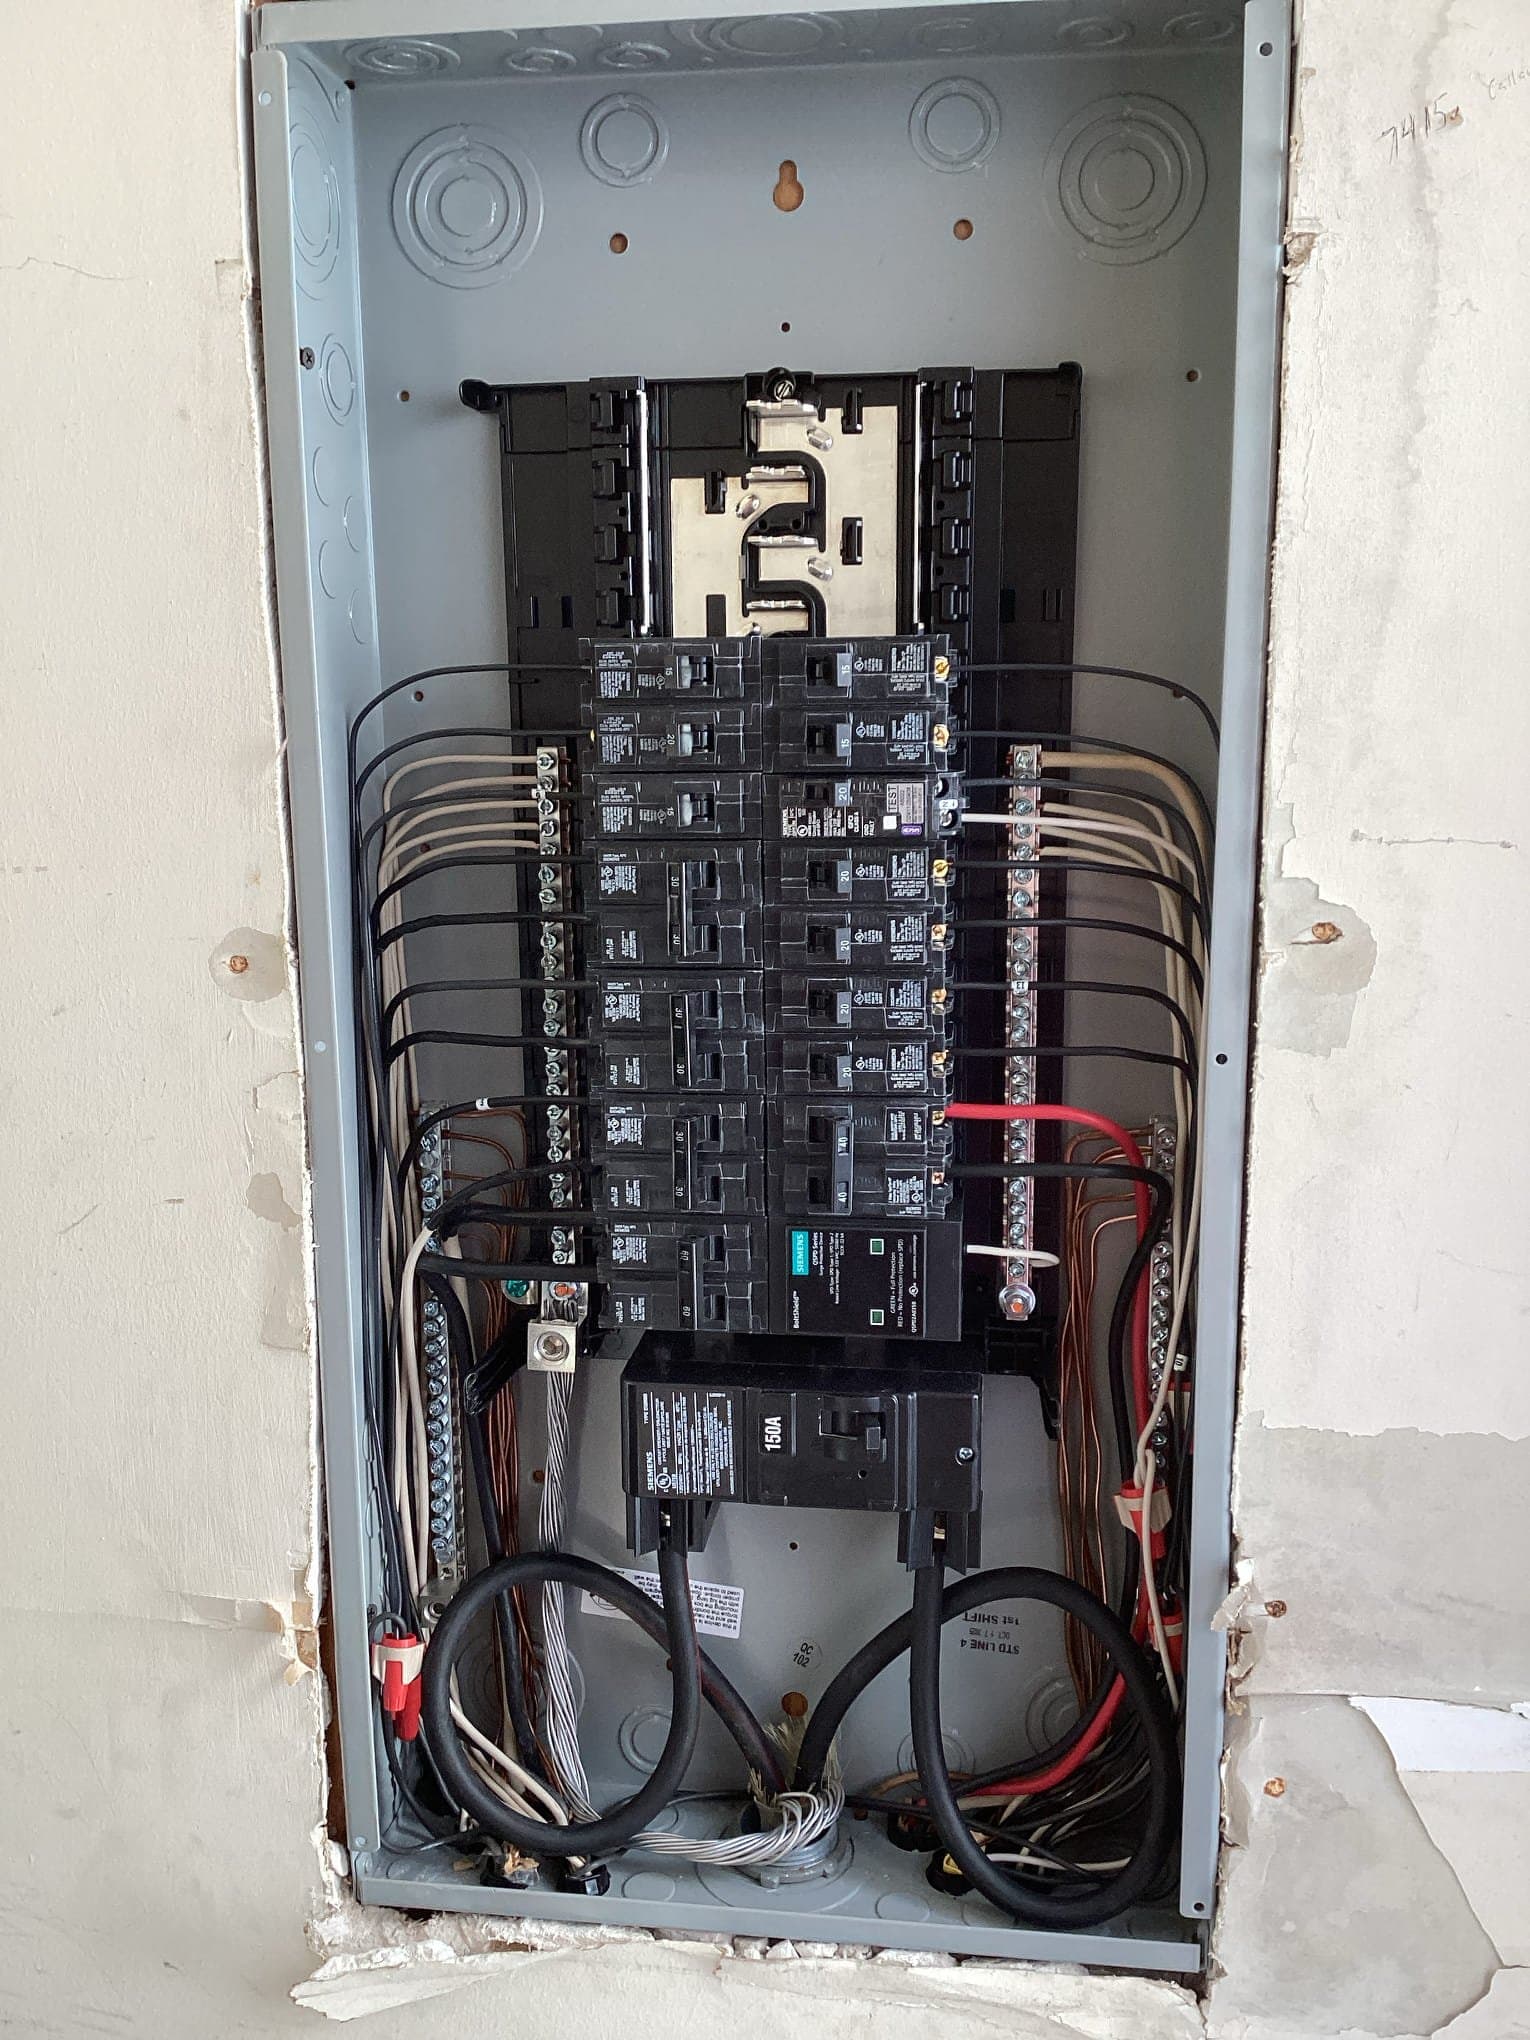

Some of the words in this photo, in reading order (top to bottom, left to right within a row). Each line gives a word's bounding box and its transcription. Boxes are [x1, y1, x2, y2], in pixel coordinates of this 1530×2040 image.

[666, 667, 674, 676] 15
[840, 664, 850, 675] 15
[667, 734, 675, 745] 20
[841, 738, 850, 749] 15
[838, 787, 848, 801] 20
[888, 786, 897, 812] TEST
[667, 806, 675, 816] 15
[671, 876, 680, 887] 30
[840, 870, 850, 882] 20
[840, 940, 850, 951] 20
[840, 1003, 850, 1014] 20
[676, 1063, 685, 1074] 30
[842, 1067, 852, 1078] 20
[675, 1131, 684, 1141] 30
[838, 1137, 848, 1148] 40
[675, 1186, 684, 1197] 30
[838, 1192, 847, 1203] 40
[796, 1233, 805, 1273] SIEMENS
[764, 1416, 782, 1451] 150A
[646, 1452, 654, 1490] SIEMENS
[962, 1613, 998, 1625] SHIFT
[1002, 1616, 1019, 1625] 1st
[800, 1642, 814, 1655] QC
[960, 1639, 967, 1648] 4
[970, 1639, 995, 1651] LINE
[999, 1643, 1020, 1655] STD
[793, 1652, 810, 1668] 102
